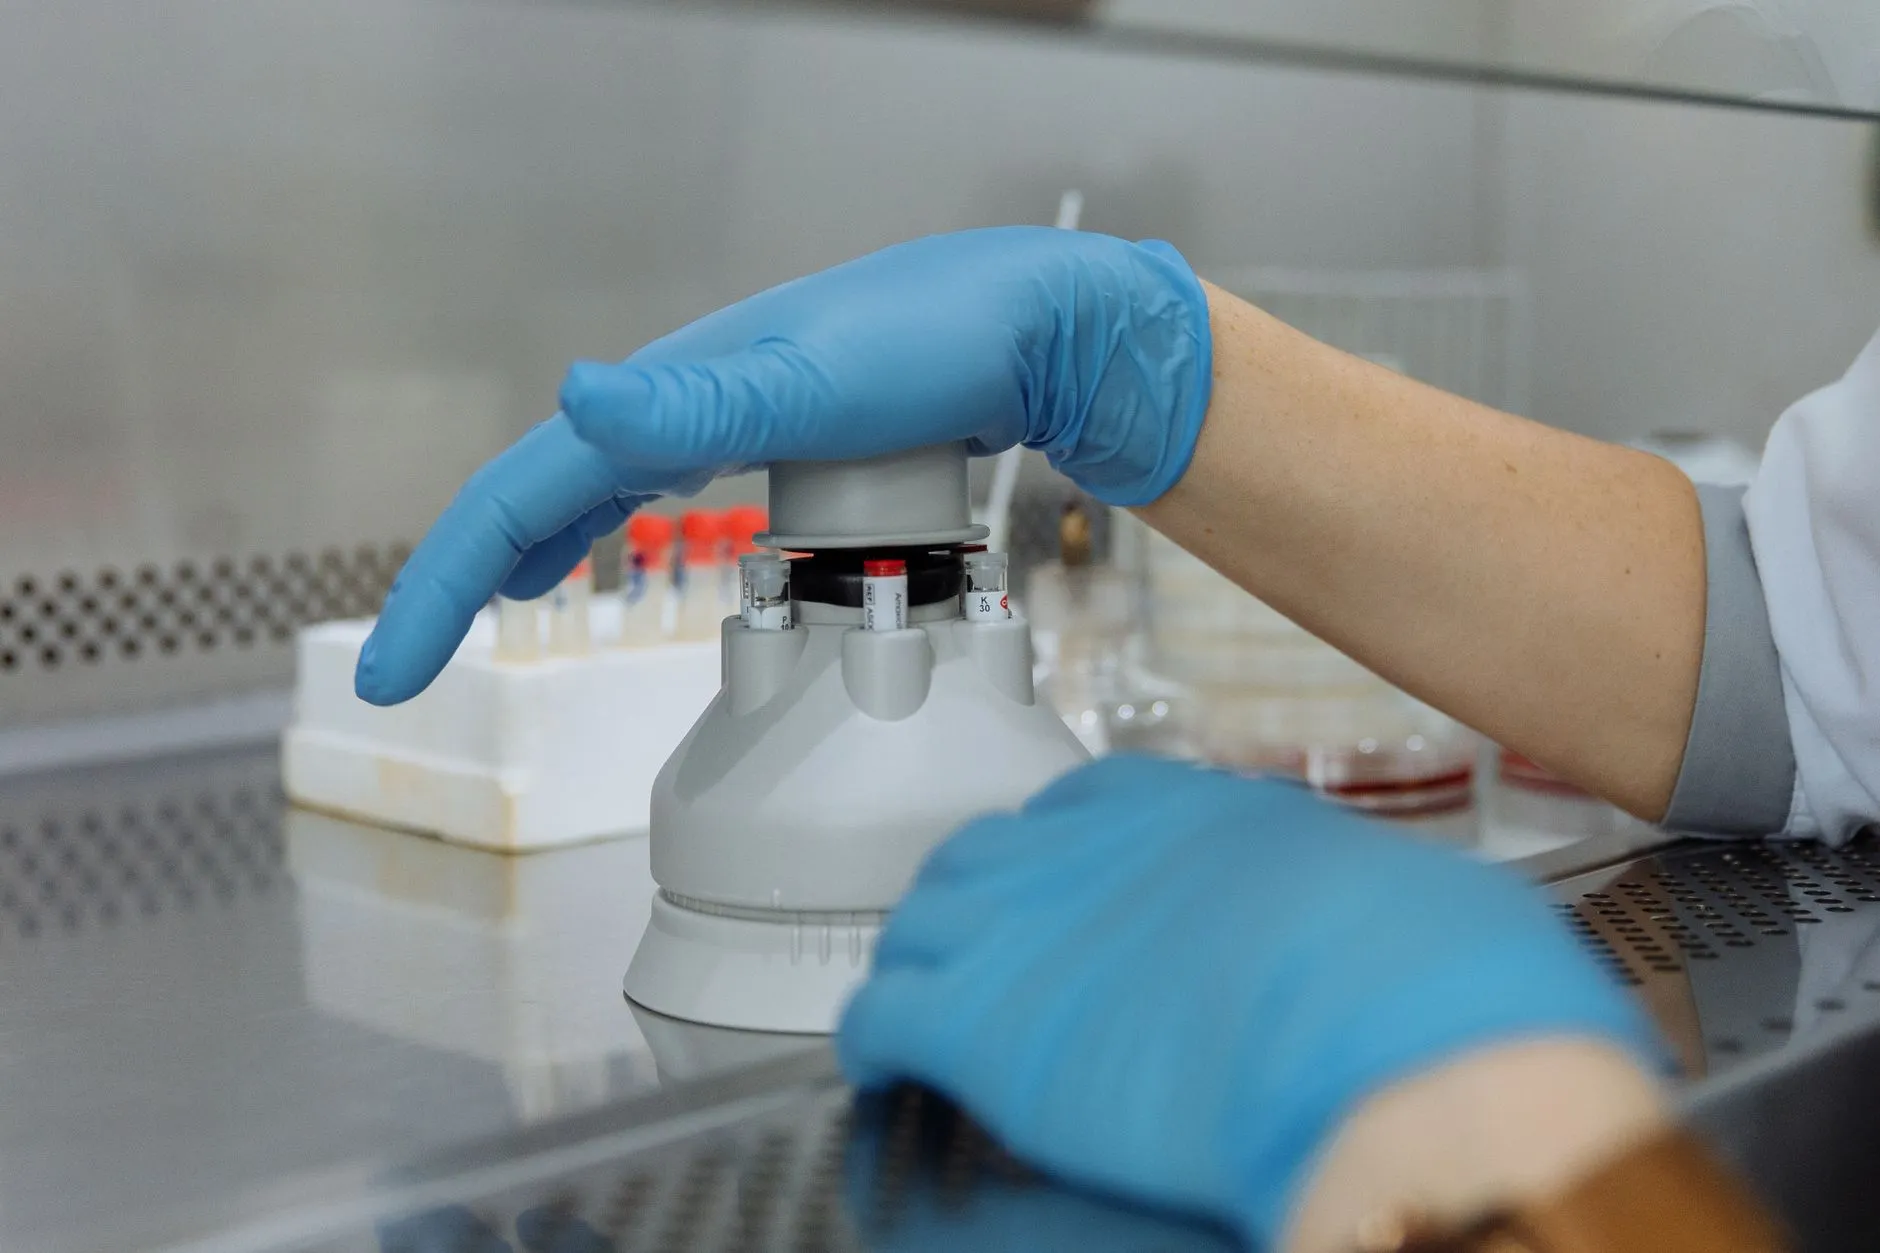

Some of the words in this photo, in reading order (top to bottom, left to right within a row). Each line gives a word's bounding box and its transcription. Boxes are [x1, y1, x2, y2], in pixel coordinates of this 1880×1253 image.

[981, 596, 988, 604] K
[979, 604, 991, 613] 30
[782, 616, 788, 624] P
